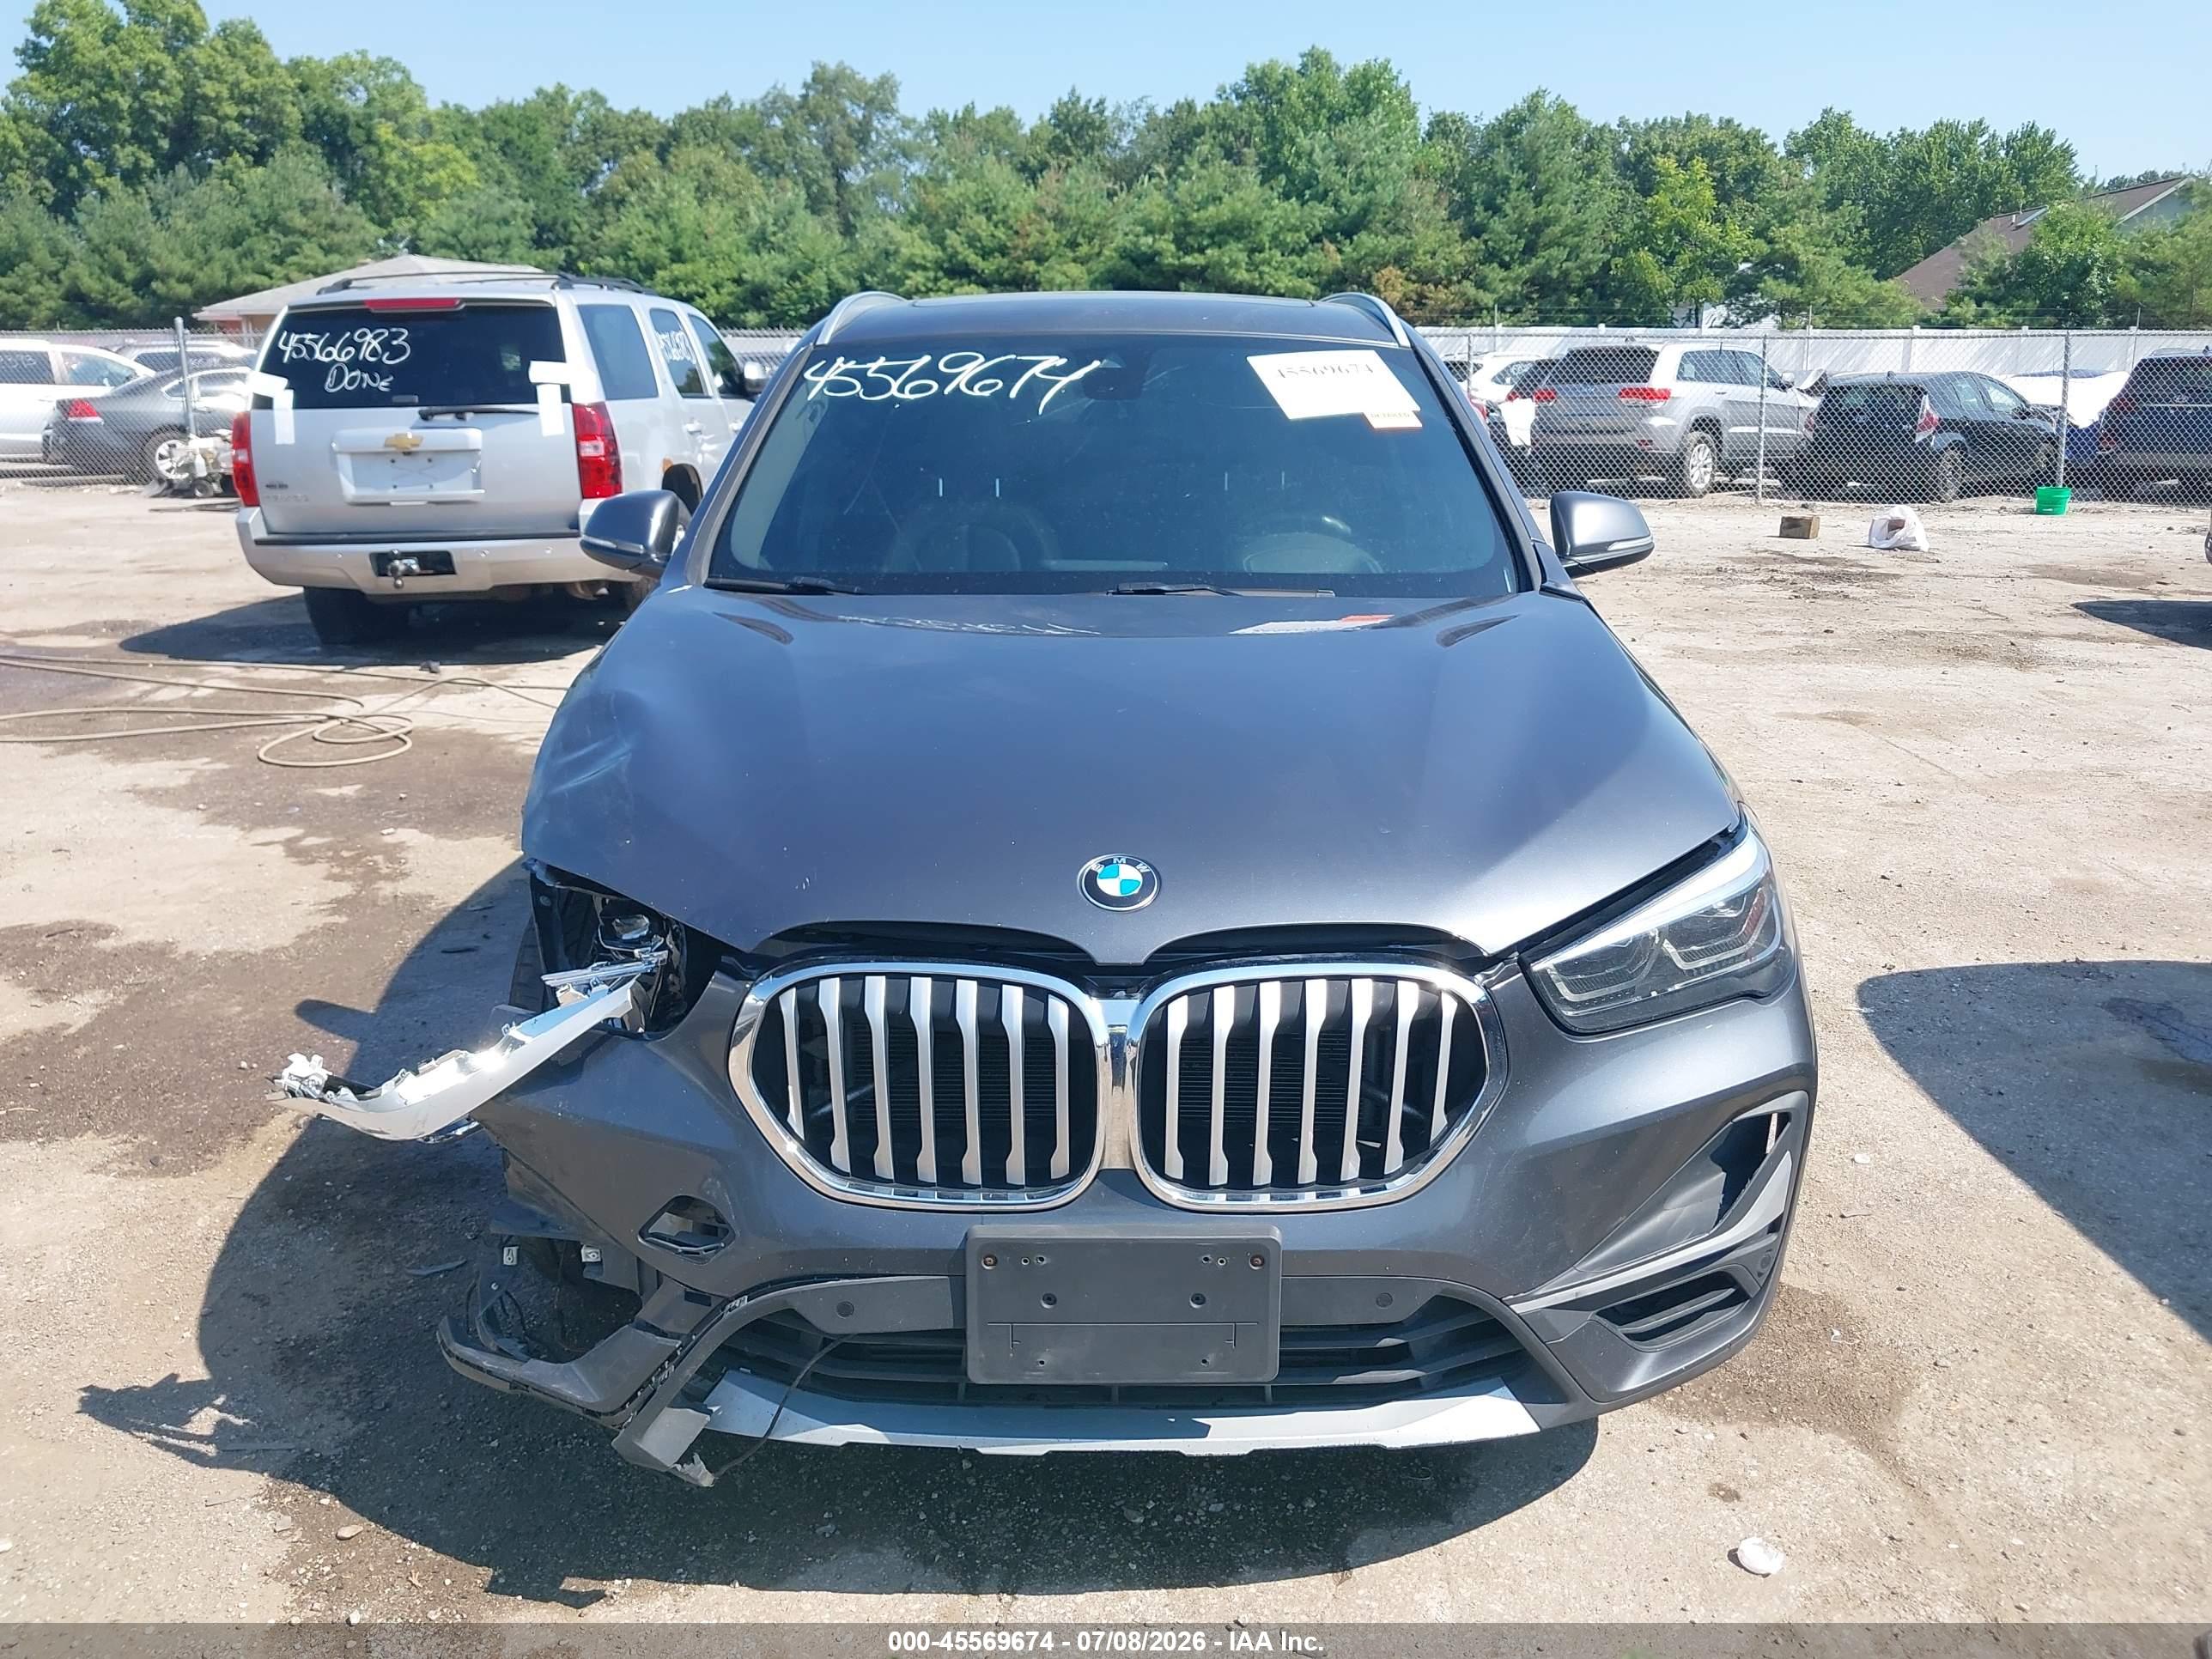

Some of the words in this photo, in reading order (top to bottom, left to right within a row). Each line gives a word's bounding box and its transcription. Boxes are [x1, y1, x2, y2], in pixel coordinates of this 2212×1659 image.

[278, 327, 411, 364] 45566983
[803, 350, 1101, 415] 45569674
[1091, 857, 1151, 873] BMW
